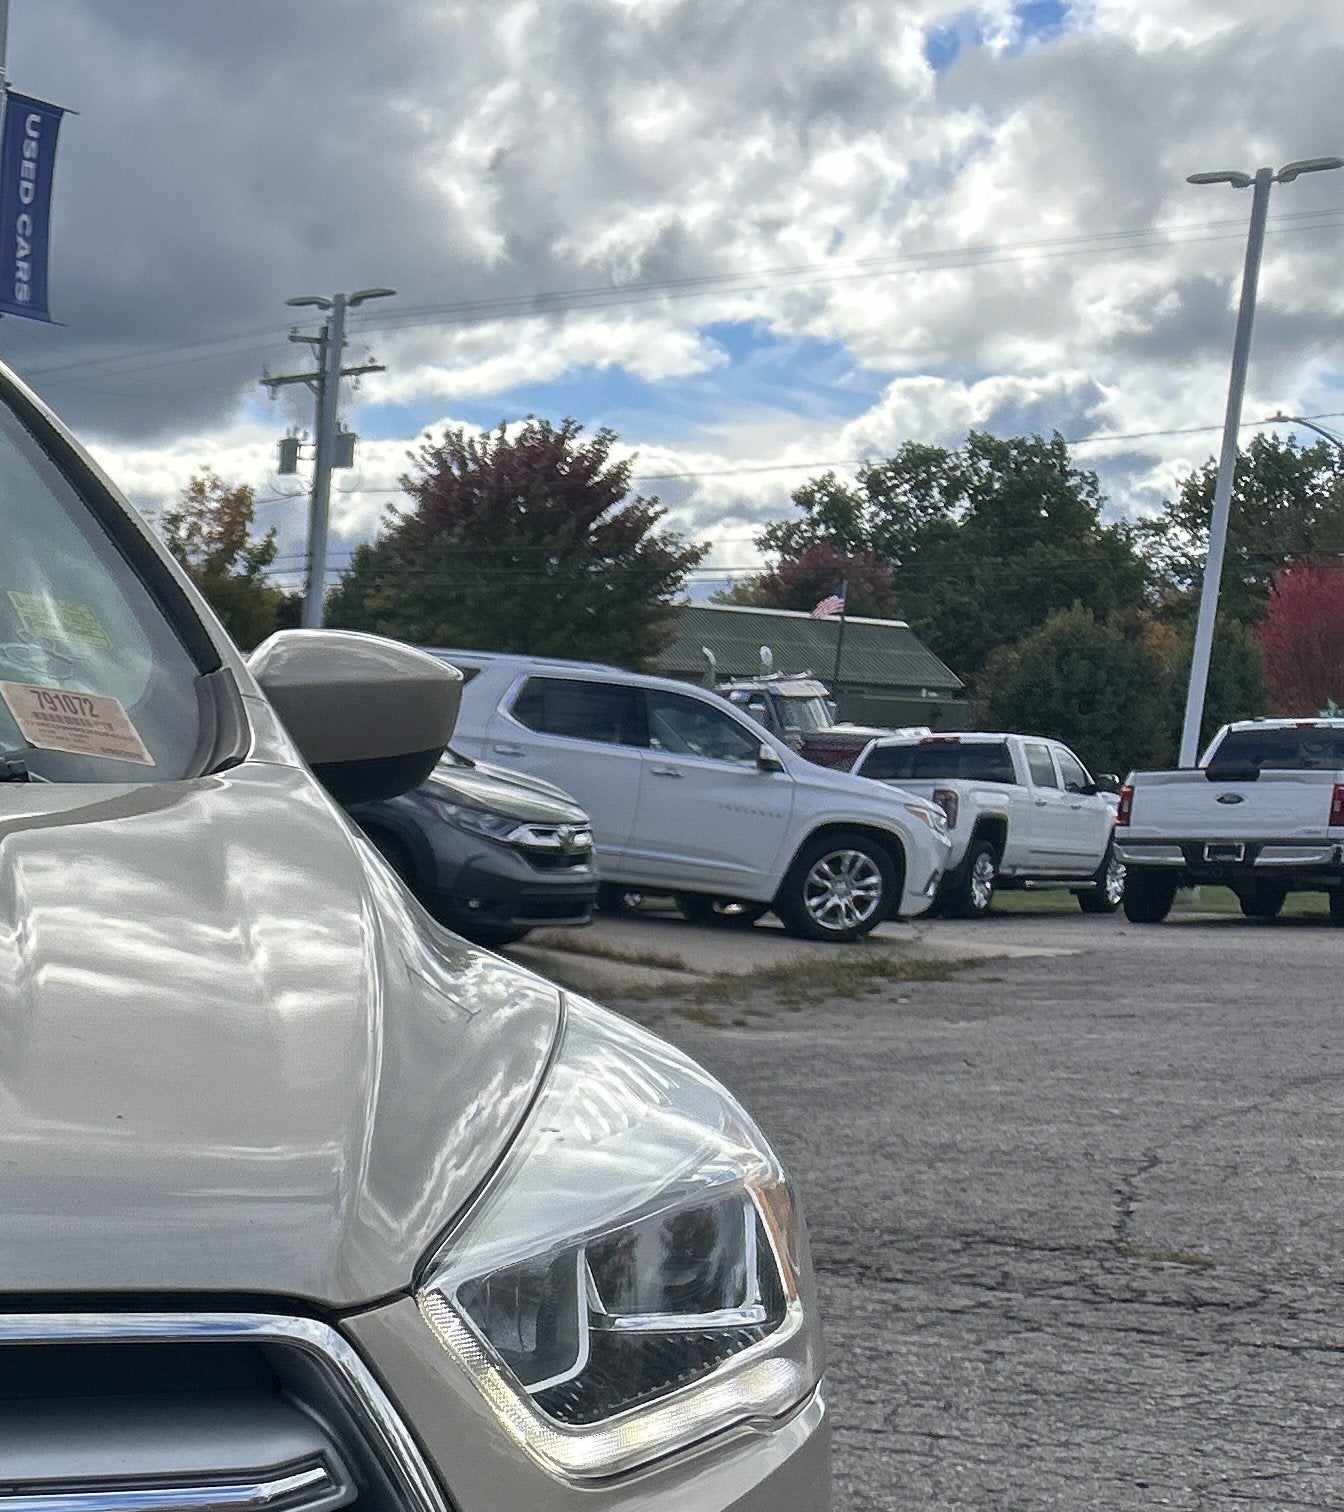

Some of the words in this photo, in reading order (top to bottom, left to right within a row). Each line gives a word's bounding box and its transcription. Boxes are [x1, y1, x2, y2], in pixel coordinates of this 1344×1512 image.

[18, 113, 42, 205] USED
[14, 213, 33, 304] CARS
[29, 689, 100, 718] 791072
